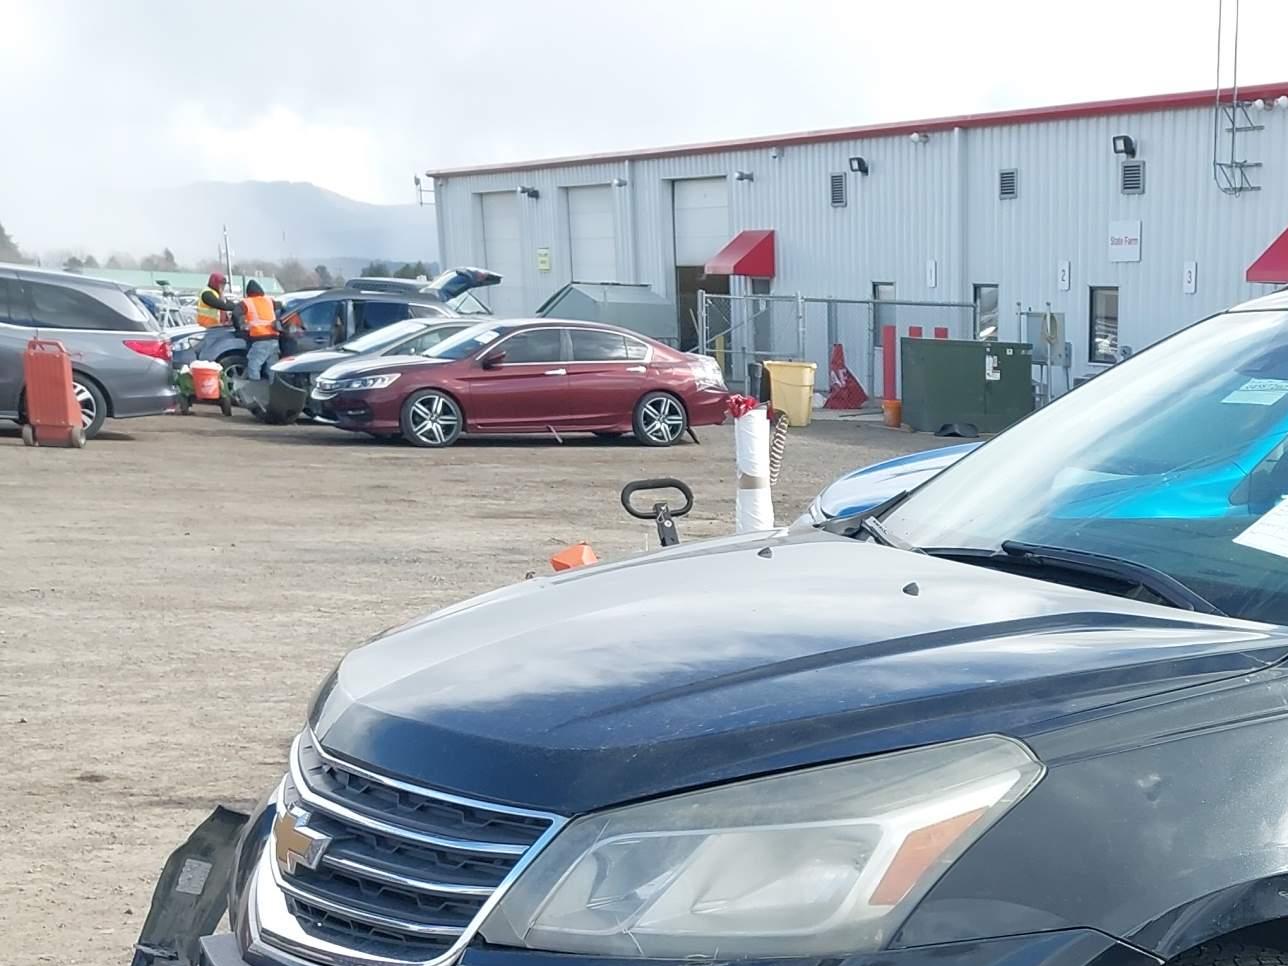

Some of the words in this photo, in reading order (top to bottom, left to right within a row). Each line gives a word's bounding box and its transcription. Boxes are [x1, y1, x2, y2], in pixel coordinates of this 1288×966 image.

[1124, 235, 1139, 246] Farm
[1061, 268, 1067, 282] 2
[1187, 270, 1193, 284] 3
